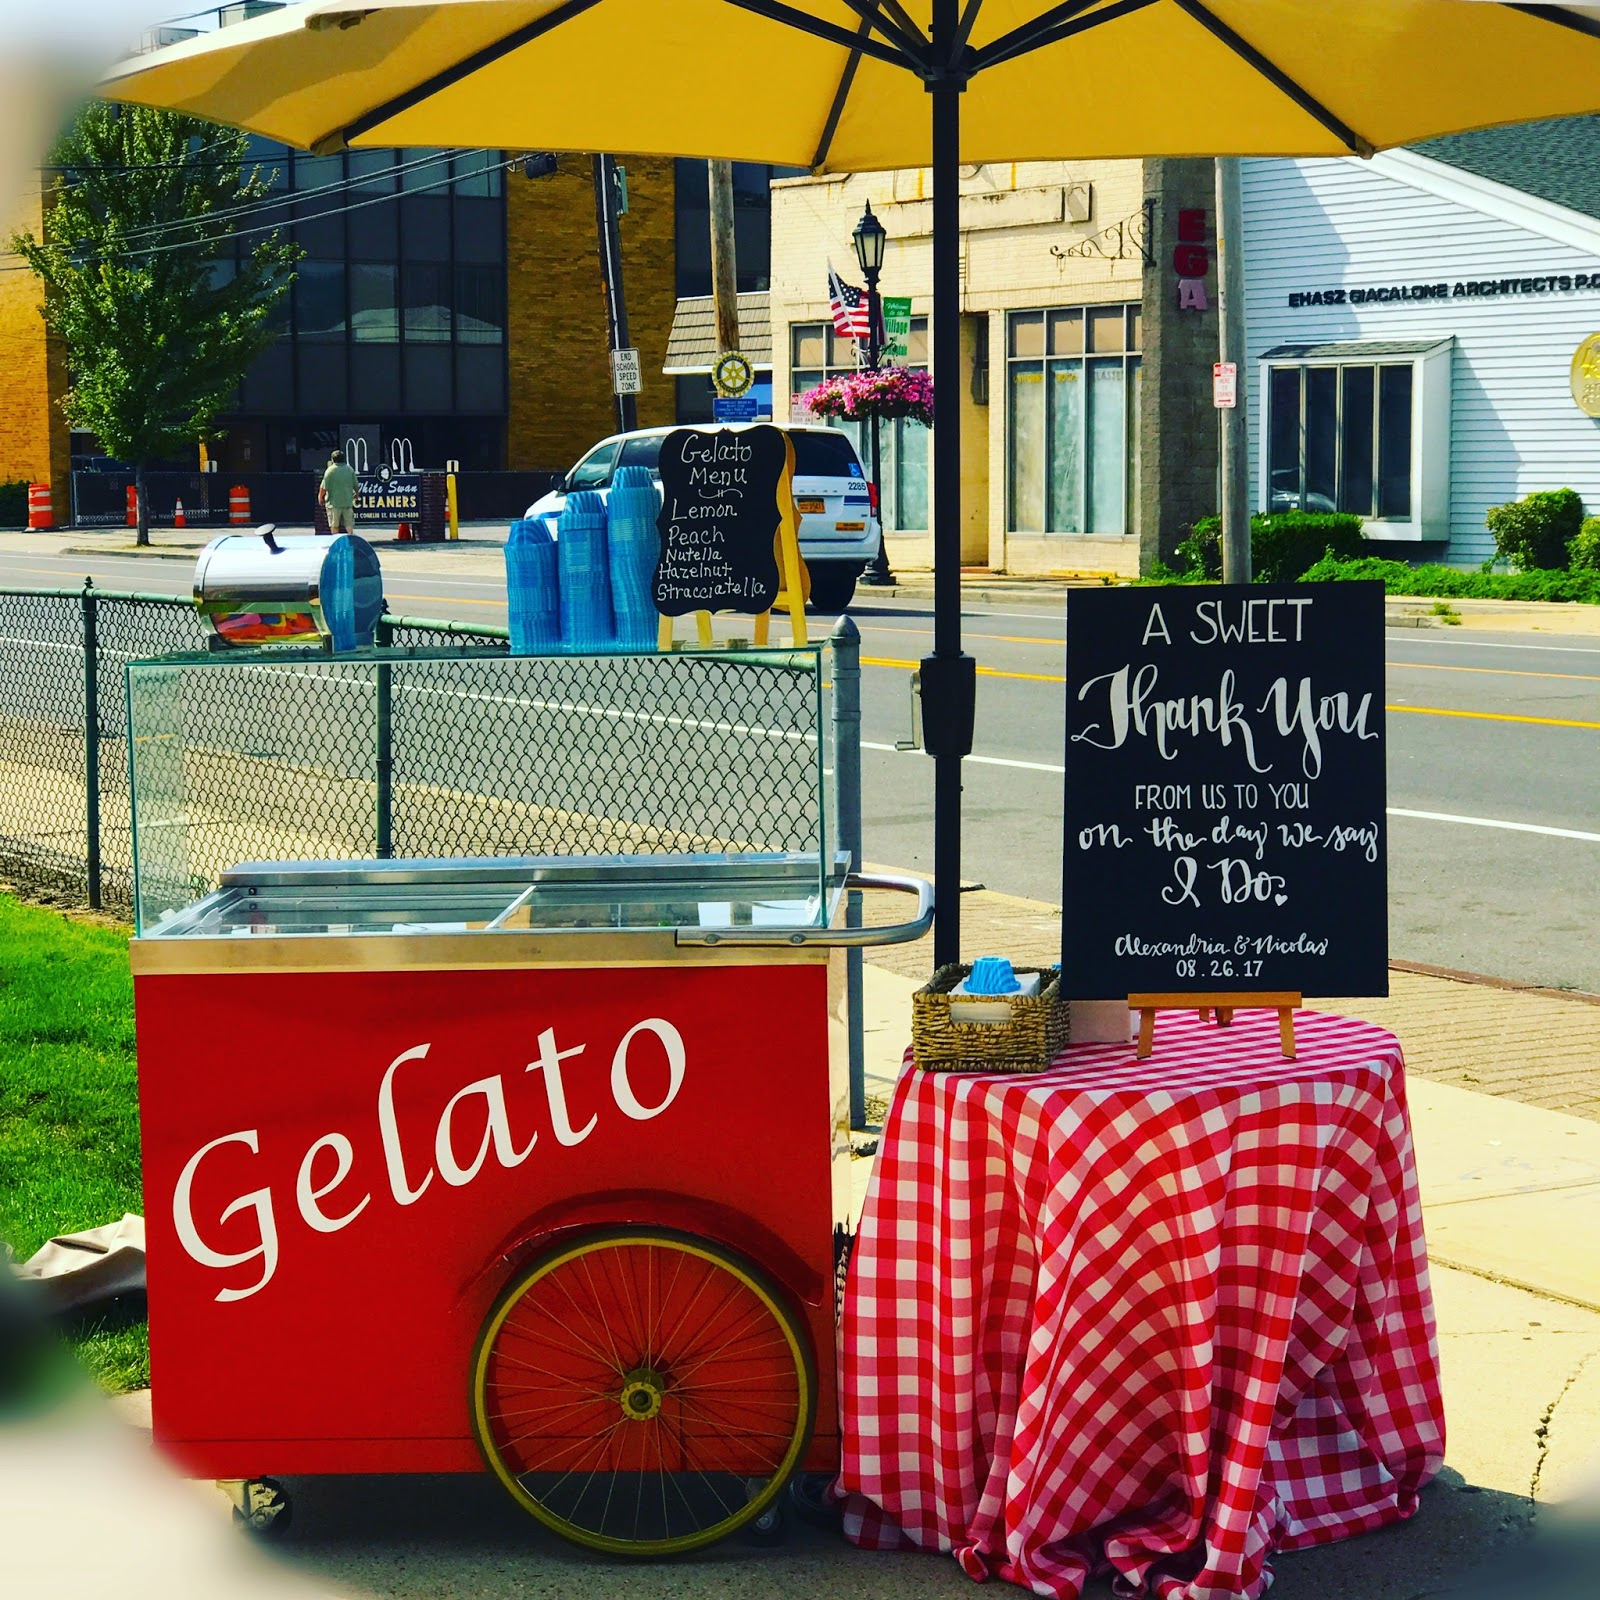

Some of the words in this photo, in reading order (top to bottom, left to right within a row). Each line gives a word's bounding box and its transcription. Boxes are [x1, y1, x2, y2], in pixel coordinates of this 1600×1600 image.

[1289, 289, 1346, 307] EHASZ
[1350, 283, 1448, 303] GIACALONE
[1453, 275, 1571, 297] ARCHITECTS
[885, 318, 908, 335] Village
[616, 361, 638, 371] SCHOOL
[620, 352, 632, 361] END
[619, 371, 637, 381] SPEED
[621, 381, 636, 391] ZONE
[680, 433, 752, 464] Gelato
[689, 467, 747, 486] Menu
[388, 480, 418, 494] Swan
[352, 495, 417, 509] CLEANERS
[672, 499, 737, 520] Lemon
[669, 526, 724, 546] Peach
[666, 548, 722, 563] Nutella
[658, 562, 733, 580] Hazelnut
[656, 577, 766, 602] Stracciatella
[1142, 604, 1171, 645] A
[1190, 599, 1312, 644] SWEET
[1071, 664, 1273, 773] Thank
[1257, 677, 1379, 779] You
[1136, 785, 1190, 809] FROM
[1203, 785, 1225, 809] US
[1234, 784, 1257, 808] TO
[1269, 783, 1308, 809] YOU
[1079, 824, 1132, 849] on
[1144, 817, 1207, 851] the
[1212, 816, 1267, 860] day
[1277, 823, 1322, 847] we
[1323, 822, 1377, 862] say
[1162, 857, 1200, 907] I
[1207, 857, 1285, 904] Do
[1115, 934, 1230, 956] Alexandria
[1235, 936, 1250, 955] &
[1251, 933, 1328, 955] Nicolas
[1177, 960, 1263, 977] 08.26.17
[173, 1018, 687, 1302] Gelato
